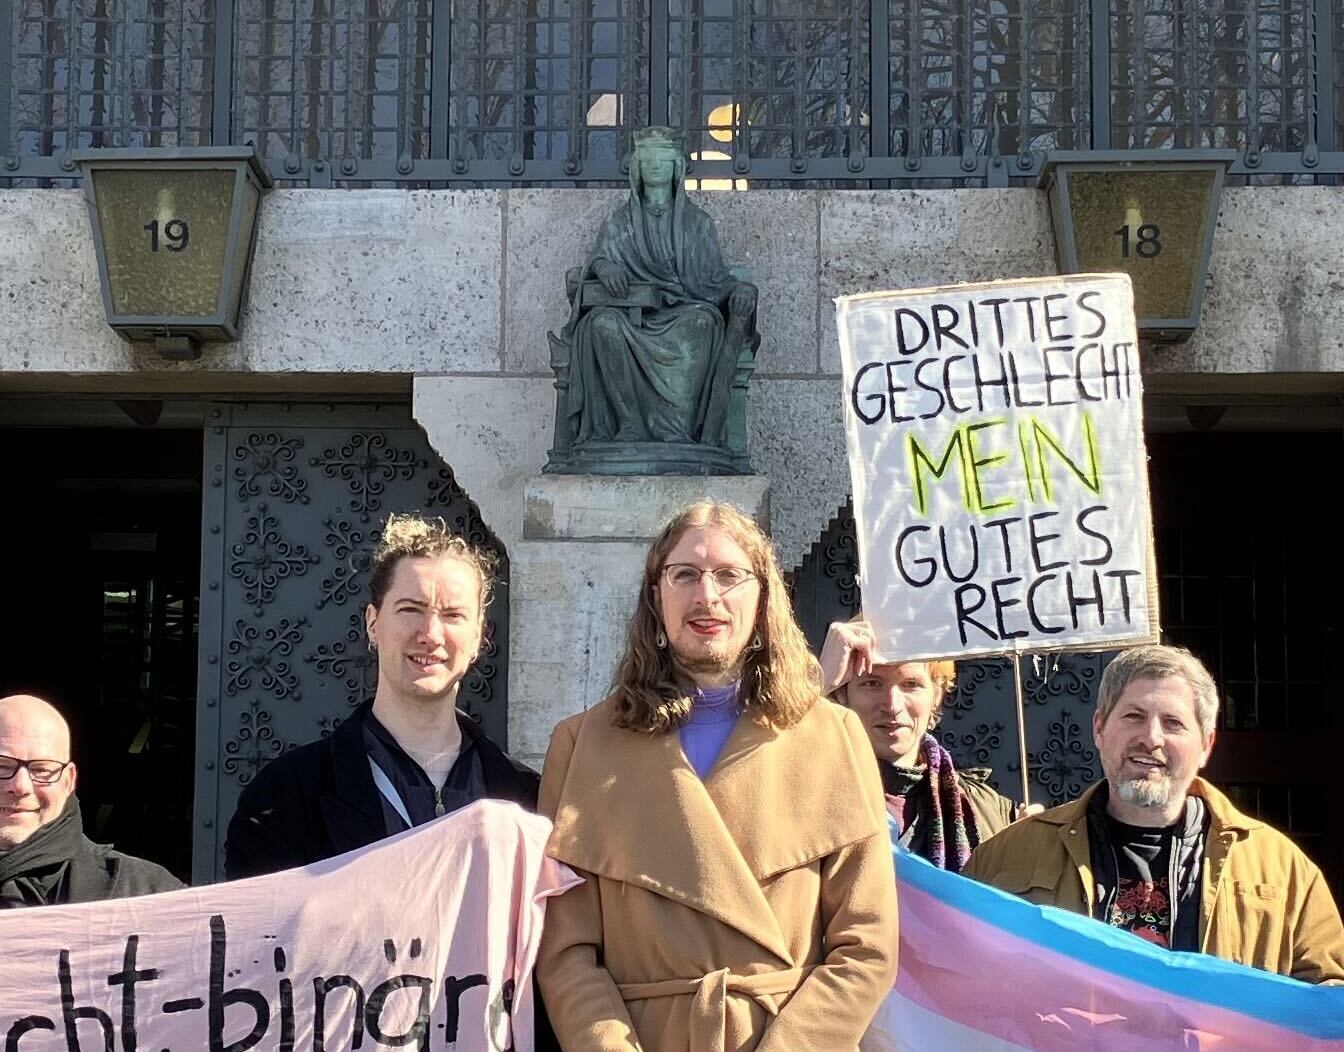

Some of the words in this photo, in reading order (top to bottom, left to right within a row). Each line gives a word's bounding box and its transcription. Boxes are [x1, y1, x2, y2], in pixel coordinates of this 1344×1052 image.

[143, 219, 189, 252] 19
[1114, 224, 1162, 258] 18
[895, 292, 1106, 355] DRITTES
[852, 342, 1133, 424] GESCHLECHT
[905, 411, 1102, 514] MEIN
[895, 506, 1113, 587] GUTES
[954, 569, 1140, 646] RECHT
